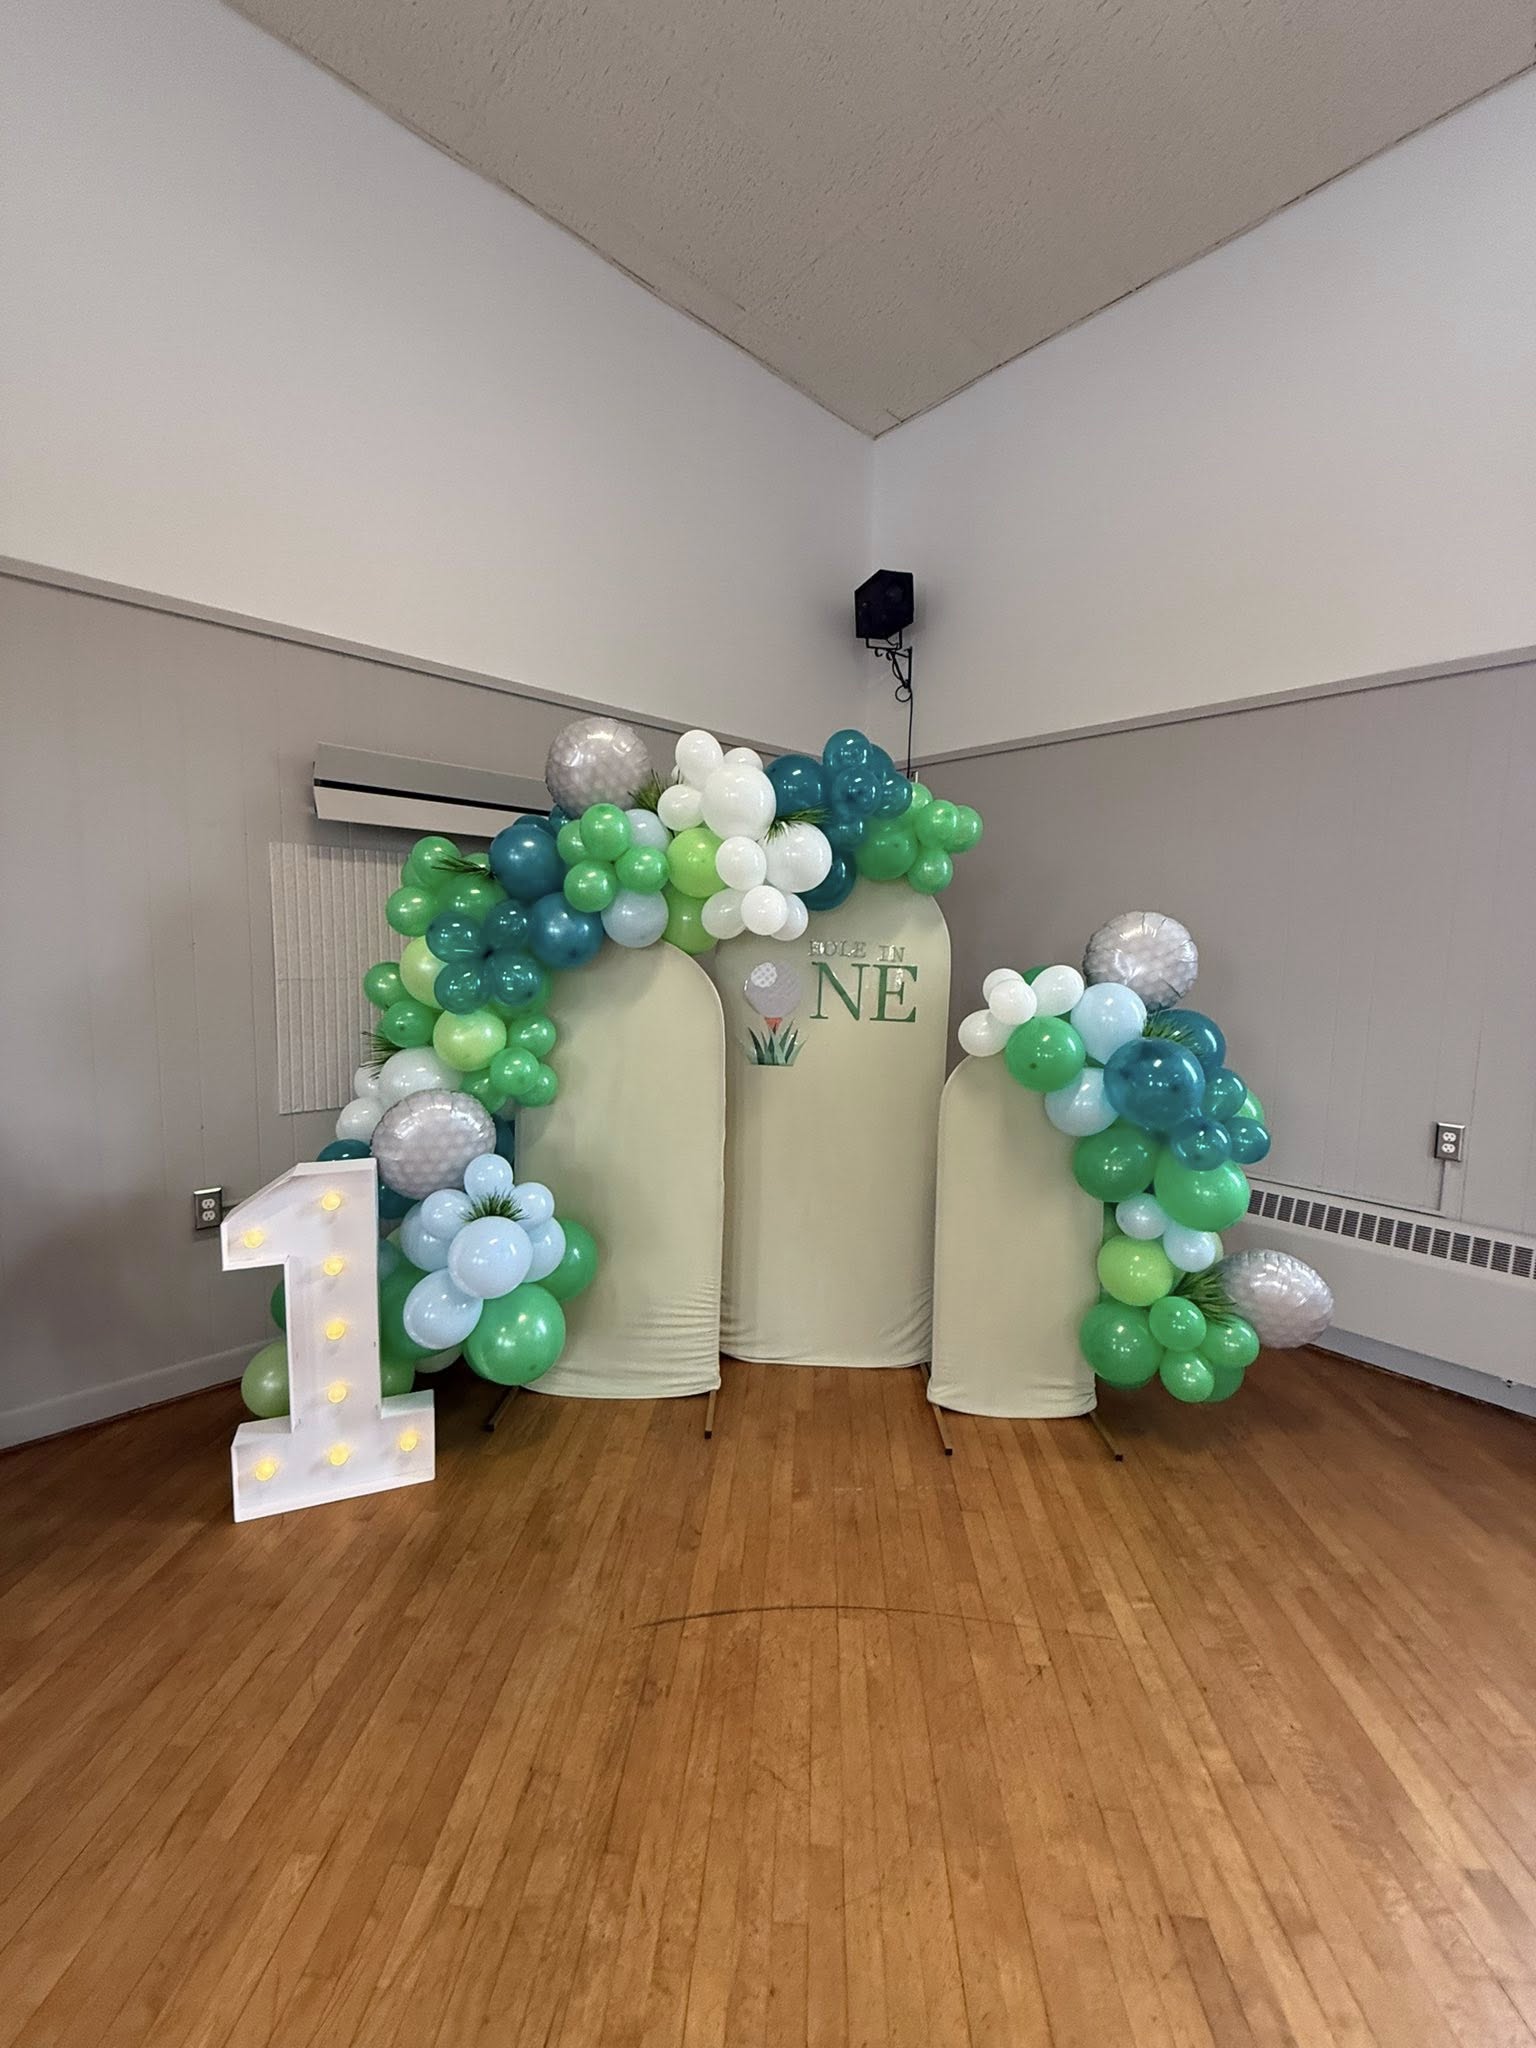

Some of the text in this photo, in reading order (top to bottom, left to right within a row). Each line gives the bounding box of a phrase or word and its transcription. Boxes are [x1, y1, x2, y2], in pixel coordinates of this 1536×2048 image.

[808, 940, 905, 962] HOLE IN
[221, 1159, 435, 1522] 1
